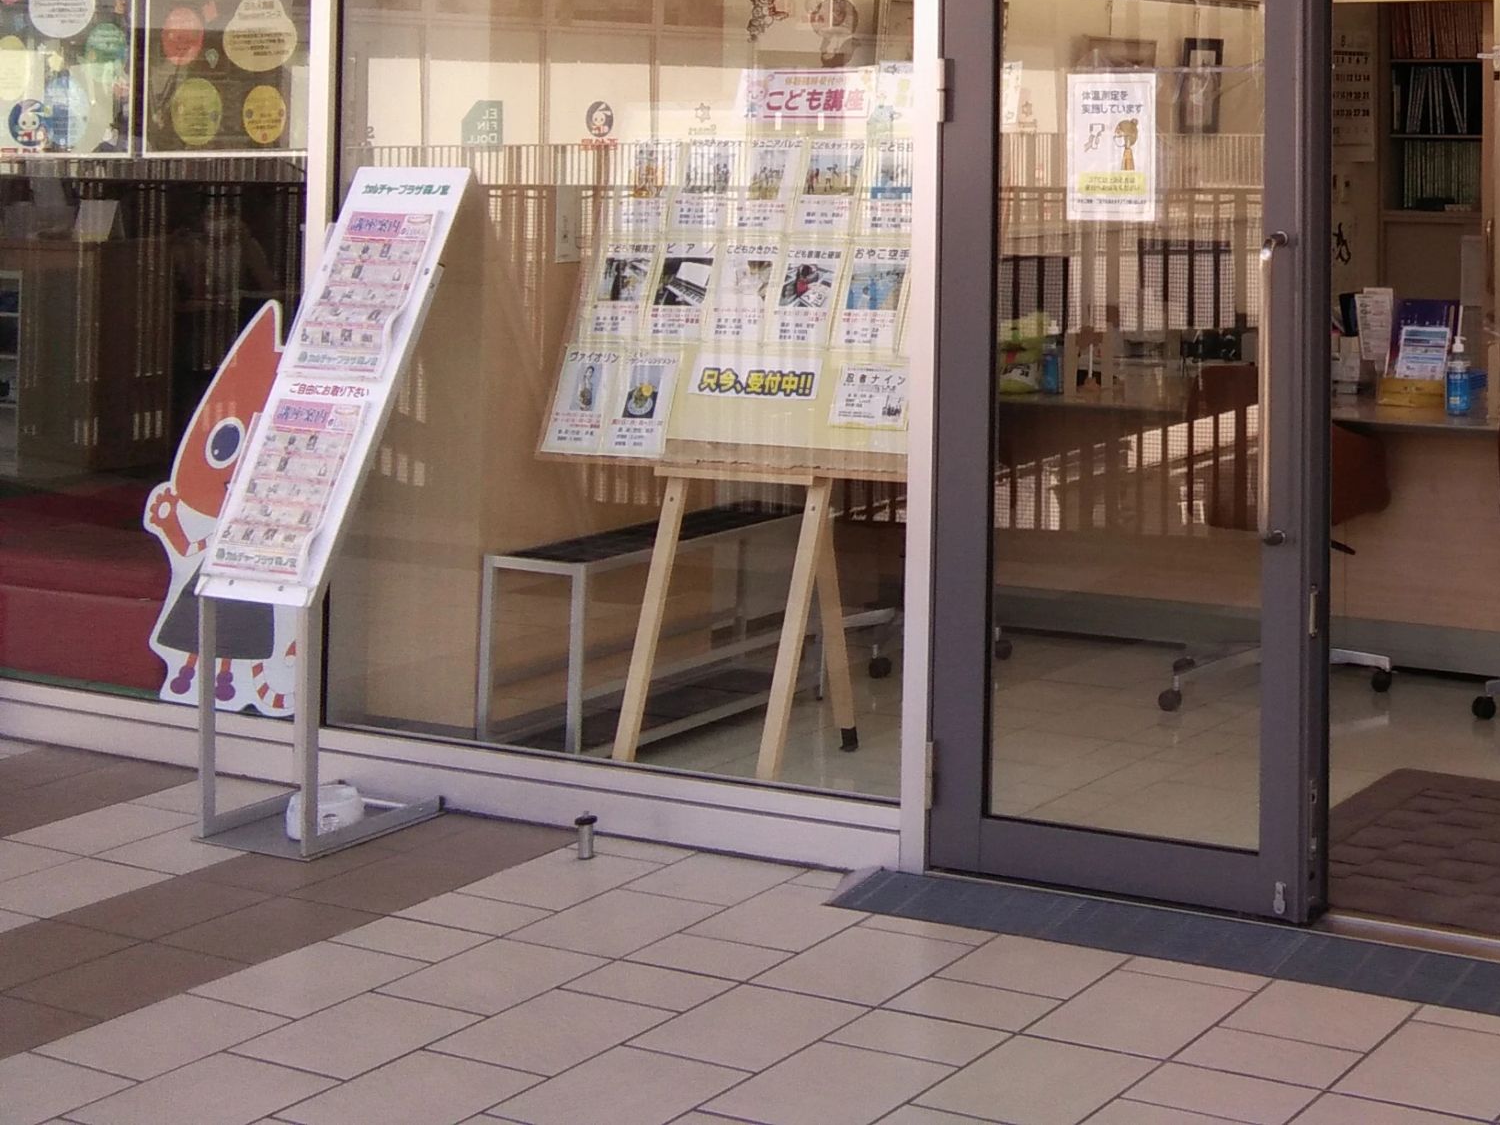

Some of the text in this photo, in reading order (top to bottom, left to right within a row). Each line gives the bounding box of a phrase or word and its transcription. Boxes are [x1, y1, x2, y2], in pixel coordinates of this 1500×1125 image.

[766, 88, 865, 112] こども講座
[1081, 90, 1129, 101] 体温測定を
[1081, 104, 1143, 115] 実施しています
[665, 242, 716, 255] ピアノ
[726, 245, 779, 255] こどもかきかた
[854, 248, 910, 261] おやこ空手
[568, 351, 620, 364] ヴァイオリン
[289, 383, 370, 398] ご自由にお取り下さい
